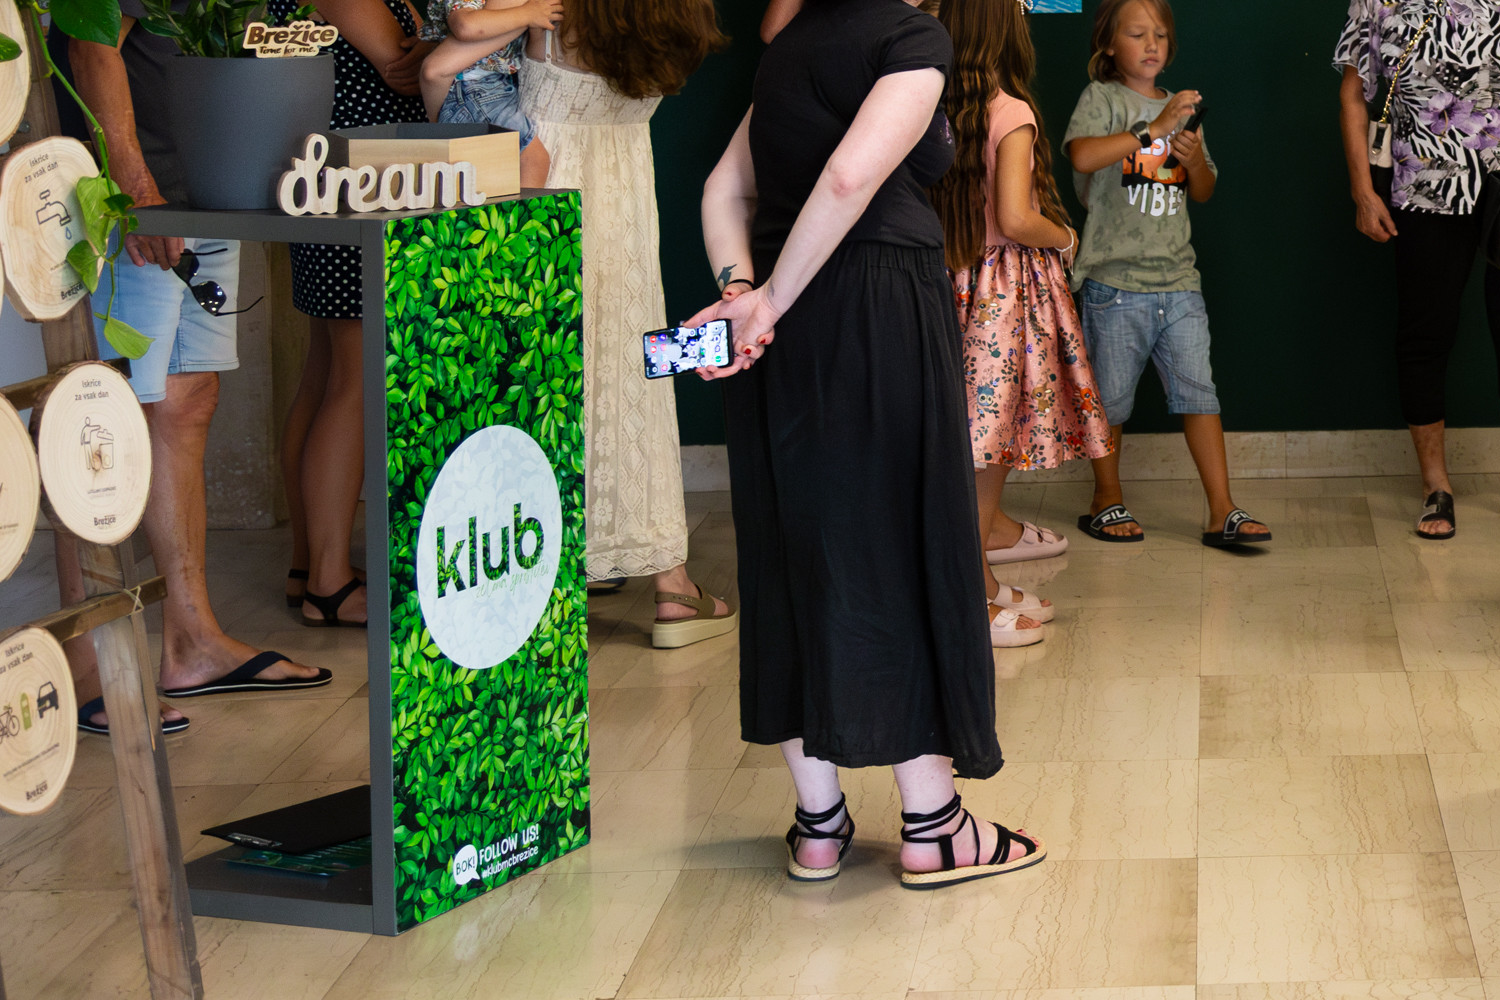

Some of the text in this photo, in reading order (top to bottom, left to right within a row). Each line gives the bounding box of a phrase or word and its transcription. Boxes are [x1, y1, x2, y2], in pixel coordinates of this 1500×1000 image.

[247, 24, 335, 46] Brežice
[33, 166, 46, 179] vsak
[47, 161, 58, 171] dan
[277, 133, 486, 216] dream
[1128, 182, 1184, 217] VIBES
[83, 391, 96, 400] vsak
[97, 390, 109, 398] dan
[436, 502, 544, 599] klub
[479, 824, 540, 865] FOLLOW US!
[456, 855, 475, 876] BOK!
